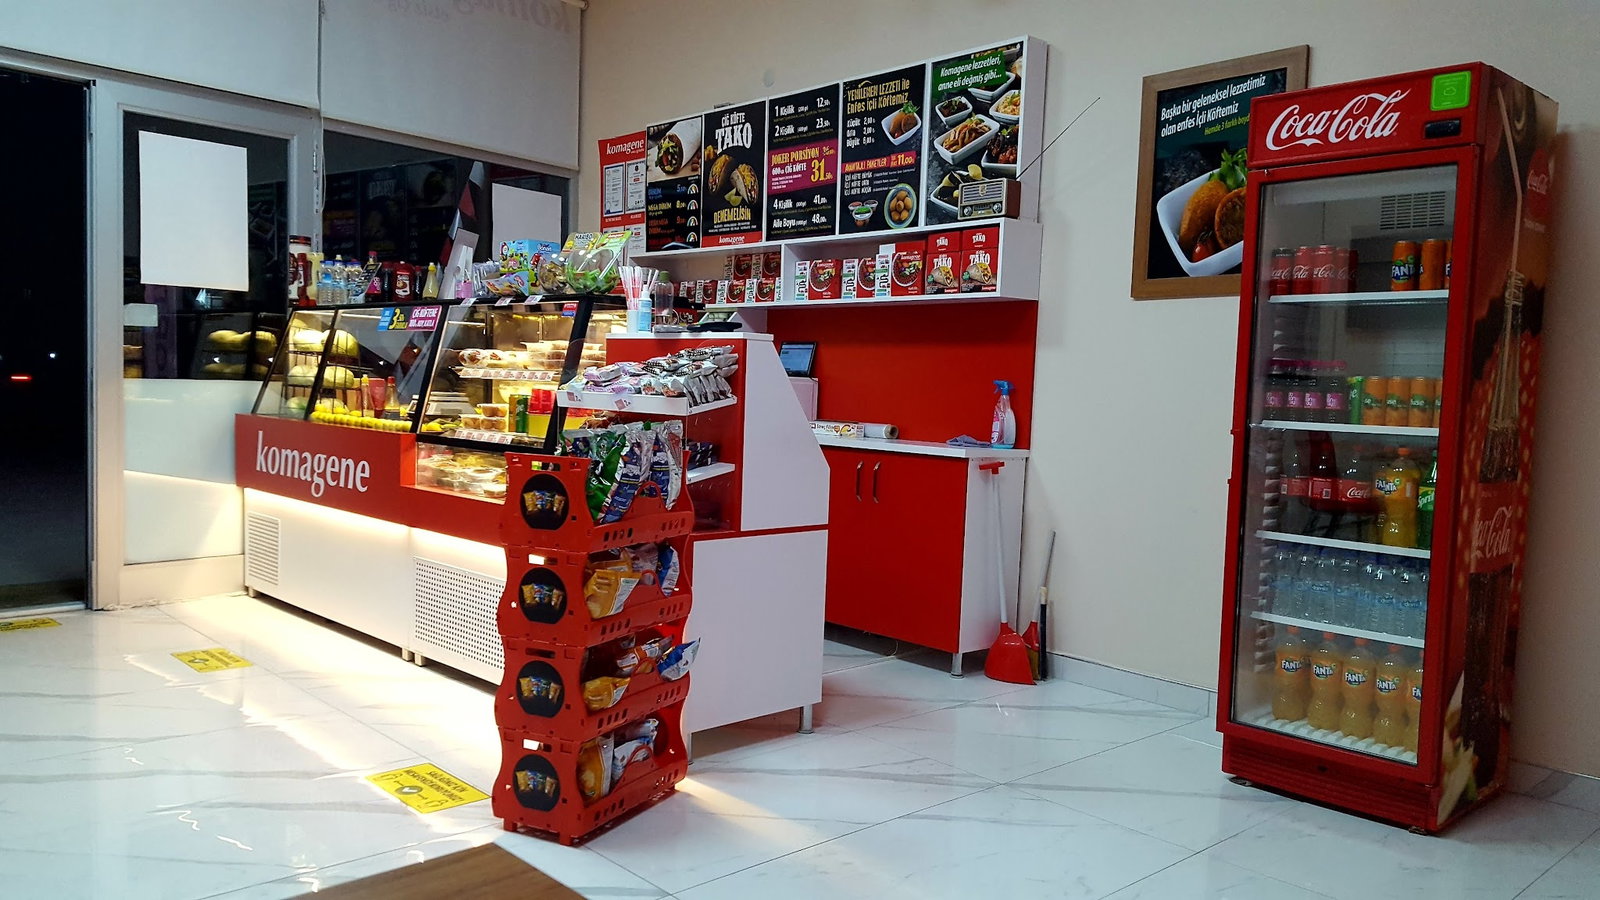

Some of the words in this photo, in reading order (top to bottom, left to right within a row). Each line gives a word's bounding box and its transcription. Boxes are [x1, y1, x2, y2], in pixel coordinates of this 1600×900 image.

[941, 63, 971, 77] Komagene
[972, 55, 1001, 69] lezzetleri,
[938, 81, 953, 90] anne
[962, 73, 983, 86] değmiş
[984, 69, 1001, 83] gibi...
[847, 101, 865, 114] Enfes
[878, 93, 908, 108] Köftemiz
[1161, 104, 1181, 121] Başka
[1182, 100, 1192, 114] bir
[1192, 86, 1230, 113] geleneksel
[1230, 74, 1266, 96] lezzetimiz
[775, 106, 778, 116] 1
[730, 112, 745, 125] KÖFTE
[1161, 123, 1176, 137] olan
[1177, 116, 1195, 132] enfes
[1196, 110, 1206, 128] İçli
[1207, 102, 1239, 122] Köftemiz
[1266, 88, 1411, 150] Coca-Cola
[775, 125, 779, 136] 2
[715, 122, 752, 156] TAKO
[607, 140, 644, 154] komagene
[771, 153, 789, 166] JOKER
[790, 147, 820, 162] PORSİYON
[793, 162, 806, 172] KÖFTE
[773, 199, 778, 209] 4
[773, 219, 782, 228] Aile
[783, 218, 795, 228] Boyu
[933, 257, 952, 269] TAKO
[969, 254, 990, 266] TAKO
[256, 430, 370, 498] komagene
[1375, 479, 1397, 493] FANTA
[1471, 506, 1514, 559] Coca-Cola
[1313, 666, 1333, 676] FANTA
[1344, 673, 1366, 683] FANTA
[1376, 680, 1396, 690] FANTA
